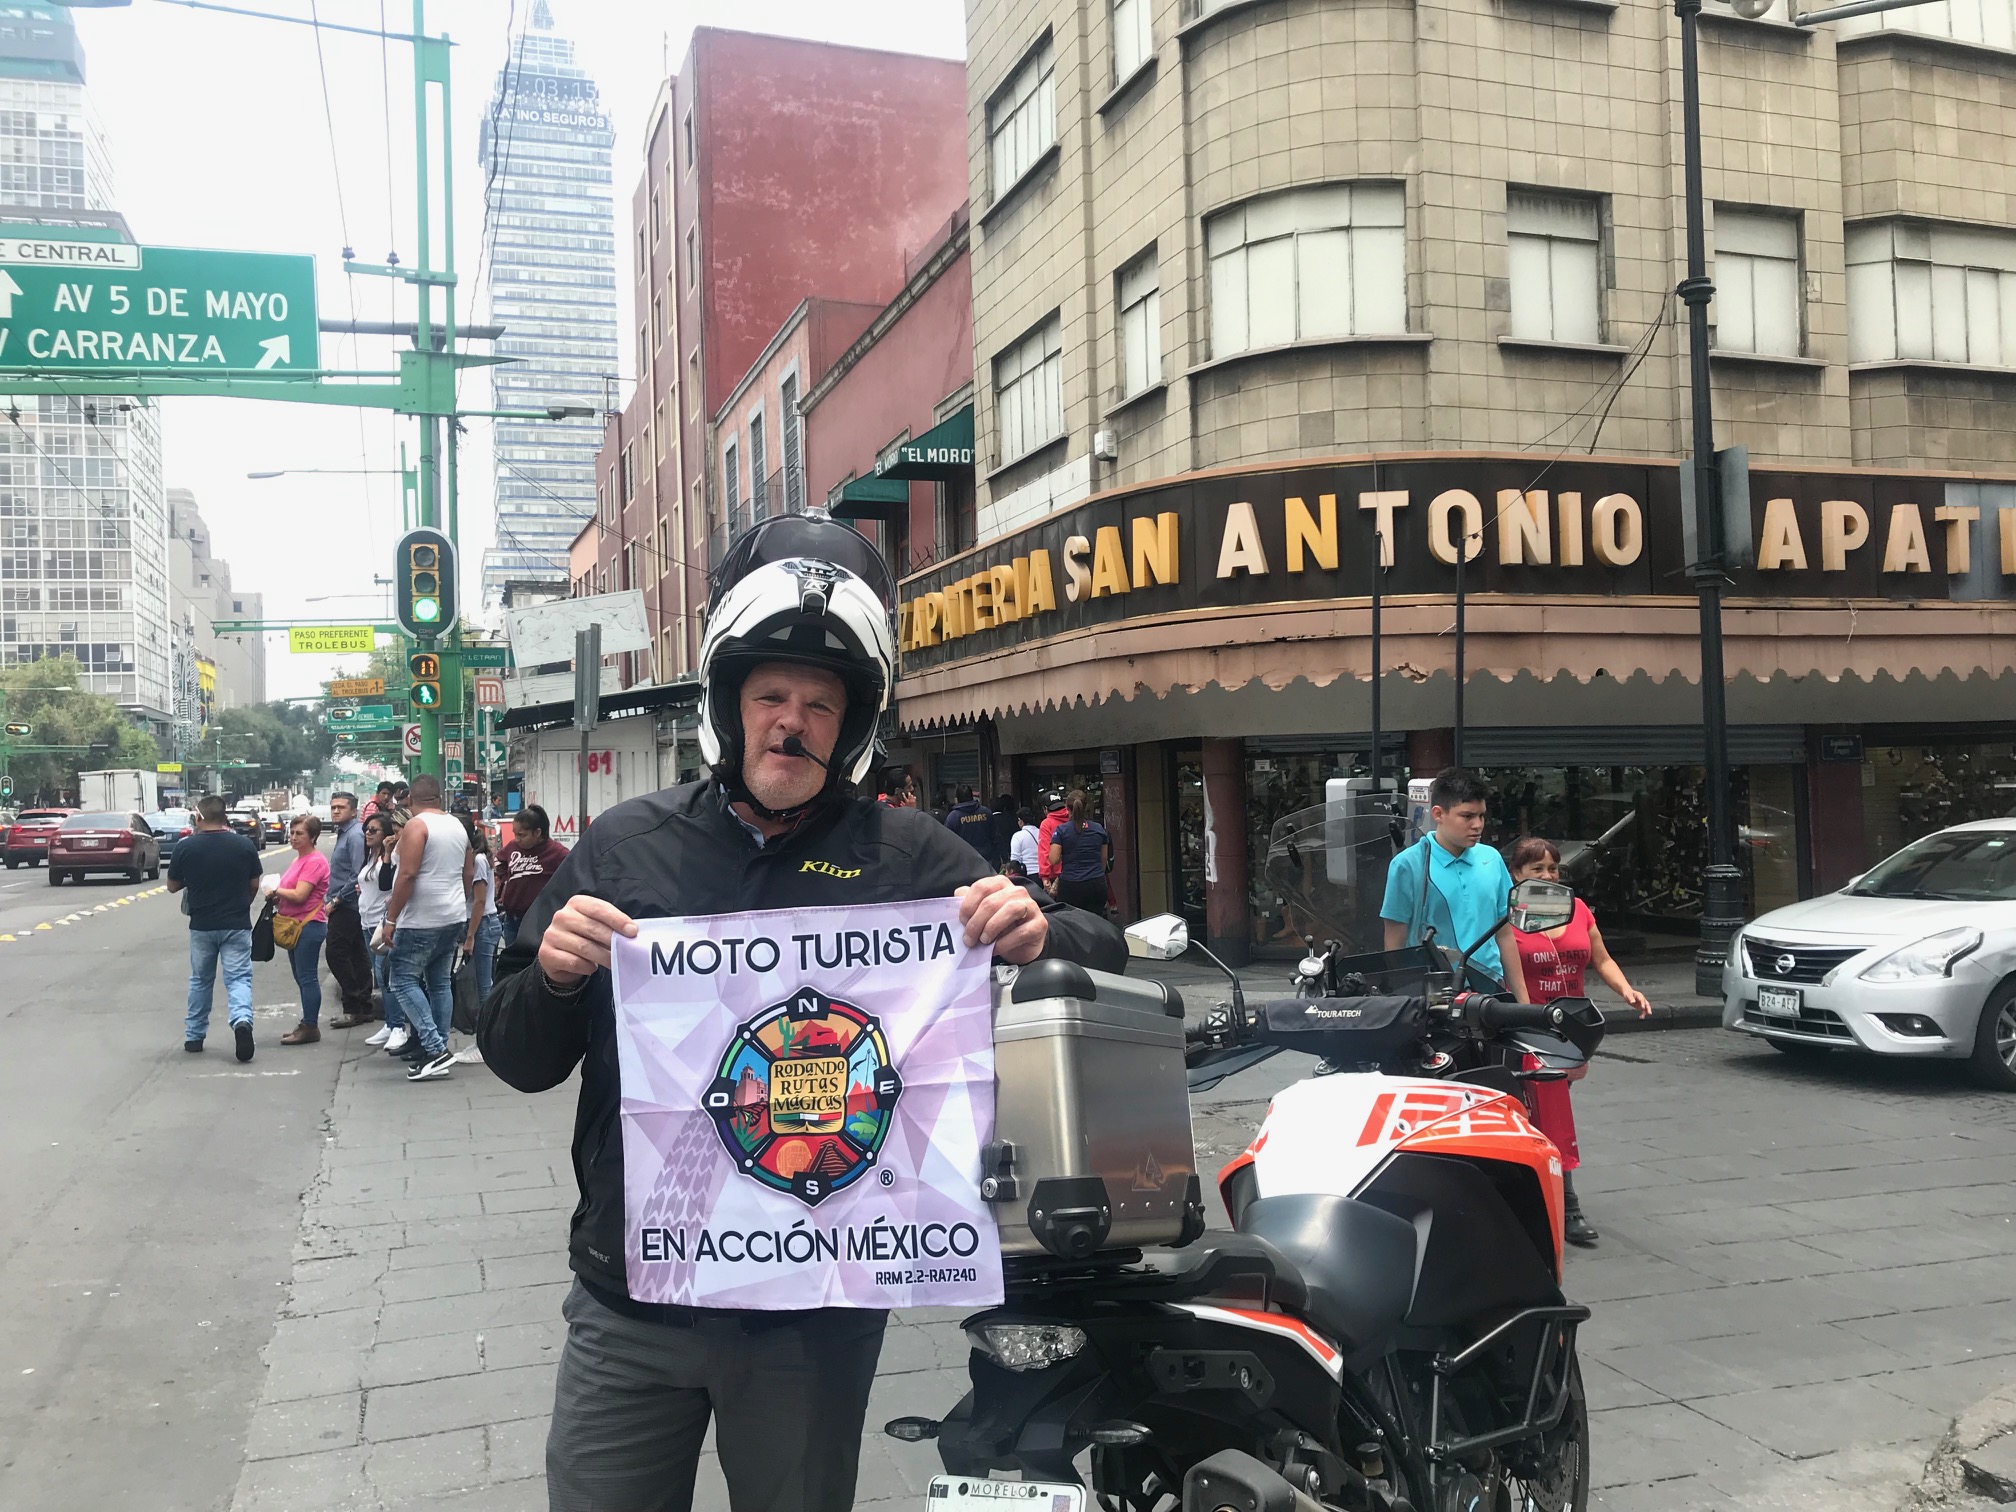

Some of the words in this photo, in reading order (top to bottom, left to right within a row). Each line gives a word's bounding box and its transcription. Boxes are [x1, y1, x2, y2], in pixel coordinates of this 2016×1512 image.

[543, 112, 605, 128] SEGUROS
[18, 242, 125, 263] CENTRAL
[54, 284, 93, 313] AV
[110, 285, 130, 315] 5
[147, 287, 189, 317] DE
[206, 290, 288, 321] MAYO
[28, 328, 226, 364] CARRANZA
[1757, 499, 2016, 575] APAT
[900, 549, 1056, 652] ZAPATERIA
[1065, 511, 1179, 602] SAN
[1216, 488, 1643, 579] ANTONIO
[295, 631, 316, 639] PASO
[319, 630, 369, 639] PREFERENTE
[299, 640, 366, 650] TROLEBUS
[960, 813, 987, 824] PUMAS
[652, 937, 780, 975] MOTO
[791, 922, 955, 971] TURISTA
[1533, 951, 1558, 963] ONLY
[1555, 964, 1579, 975] DAYS
[1539, 980, 1561, 991] THAT
[798, 998, 818, 1013] N
[1317, 1009, 1362, 1018] TOURATECH
[879, 1080, 895, 1095] E
[709, 1092, 729, 1107] O
[805, 1180, 819, 1195] S
[642, 1227, 686, 1261] EN
[694, 1219, 838, 1263] ACCIÓN
[846, 1215, 979, 1261] MÉXICO
[876, 1271, 902, 1285] RRM
[905, 1268, 977, 1284] 2.2-RA7240
[971, 1483, 1036, 1498] MORELO
